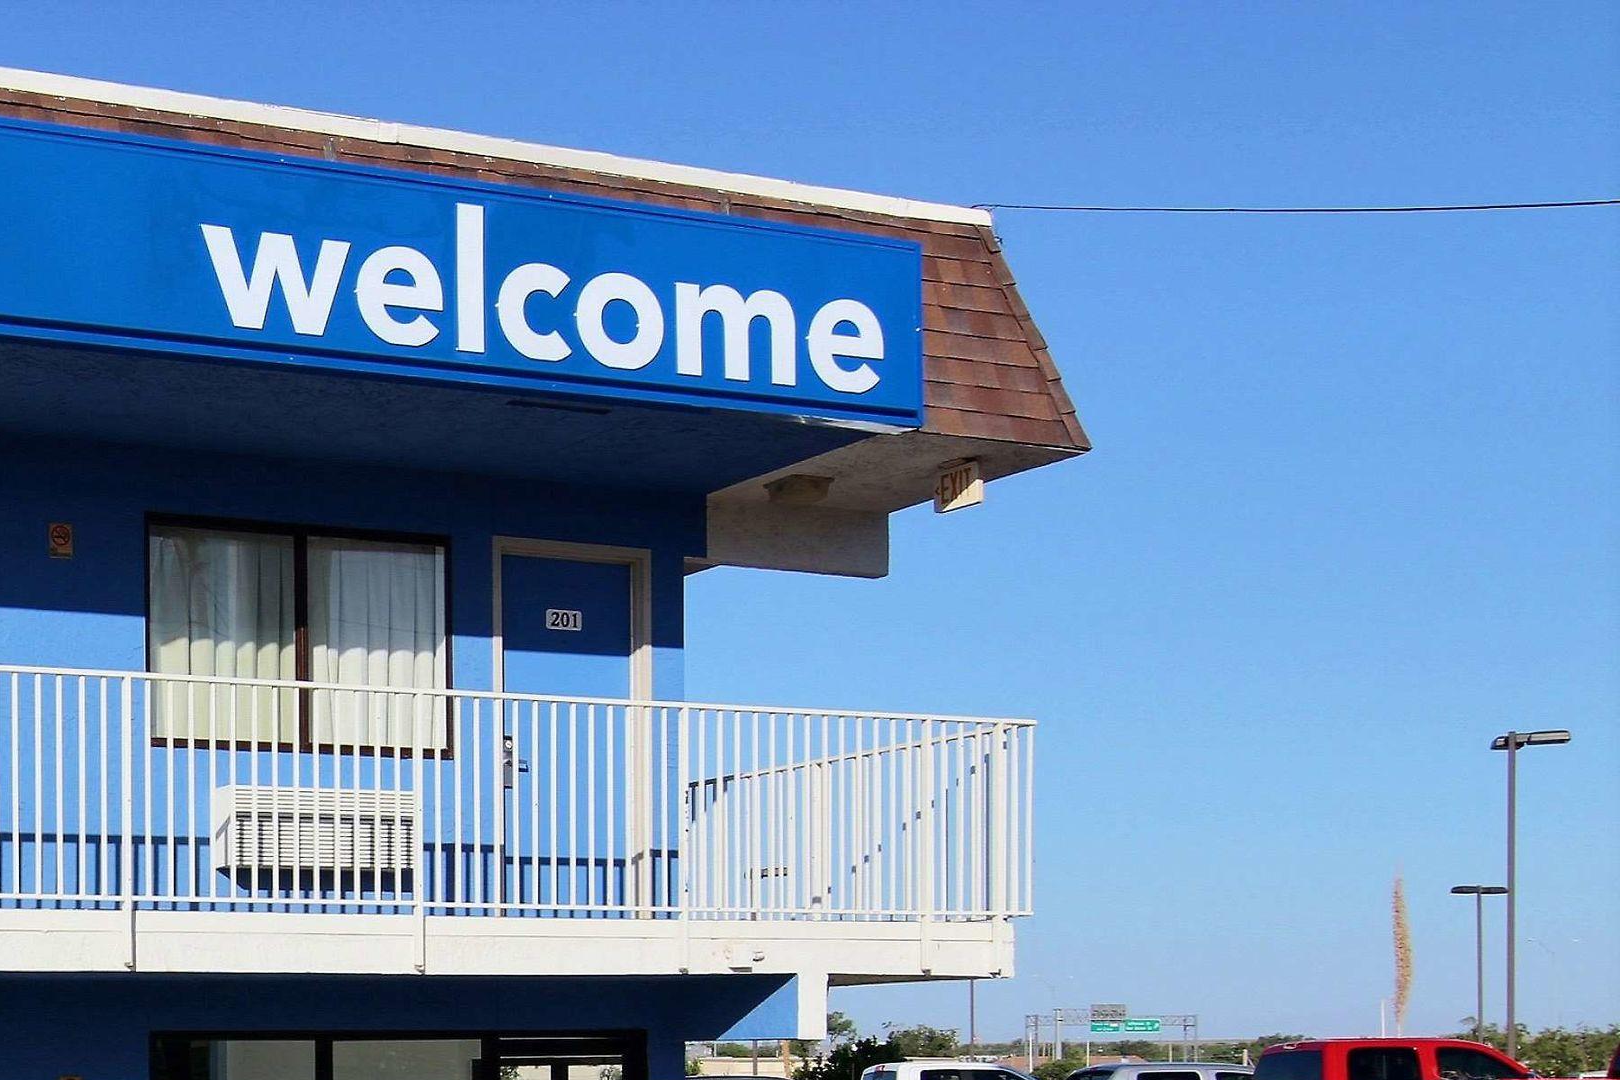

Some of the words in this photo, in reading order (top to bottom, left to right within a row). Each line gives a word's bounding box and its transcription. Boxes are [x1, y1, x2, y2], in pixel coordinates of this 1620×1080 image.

[198, 202, 885, 394] welcome
[940, 466, 973, 505] EXIT
[550, 611, 578, 629] 201
